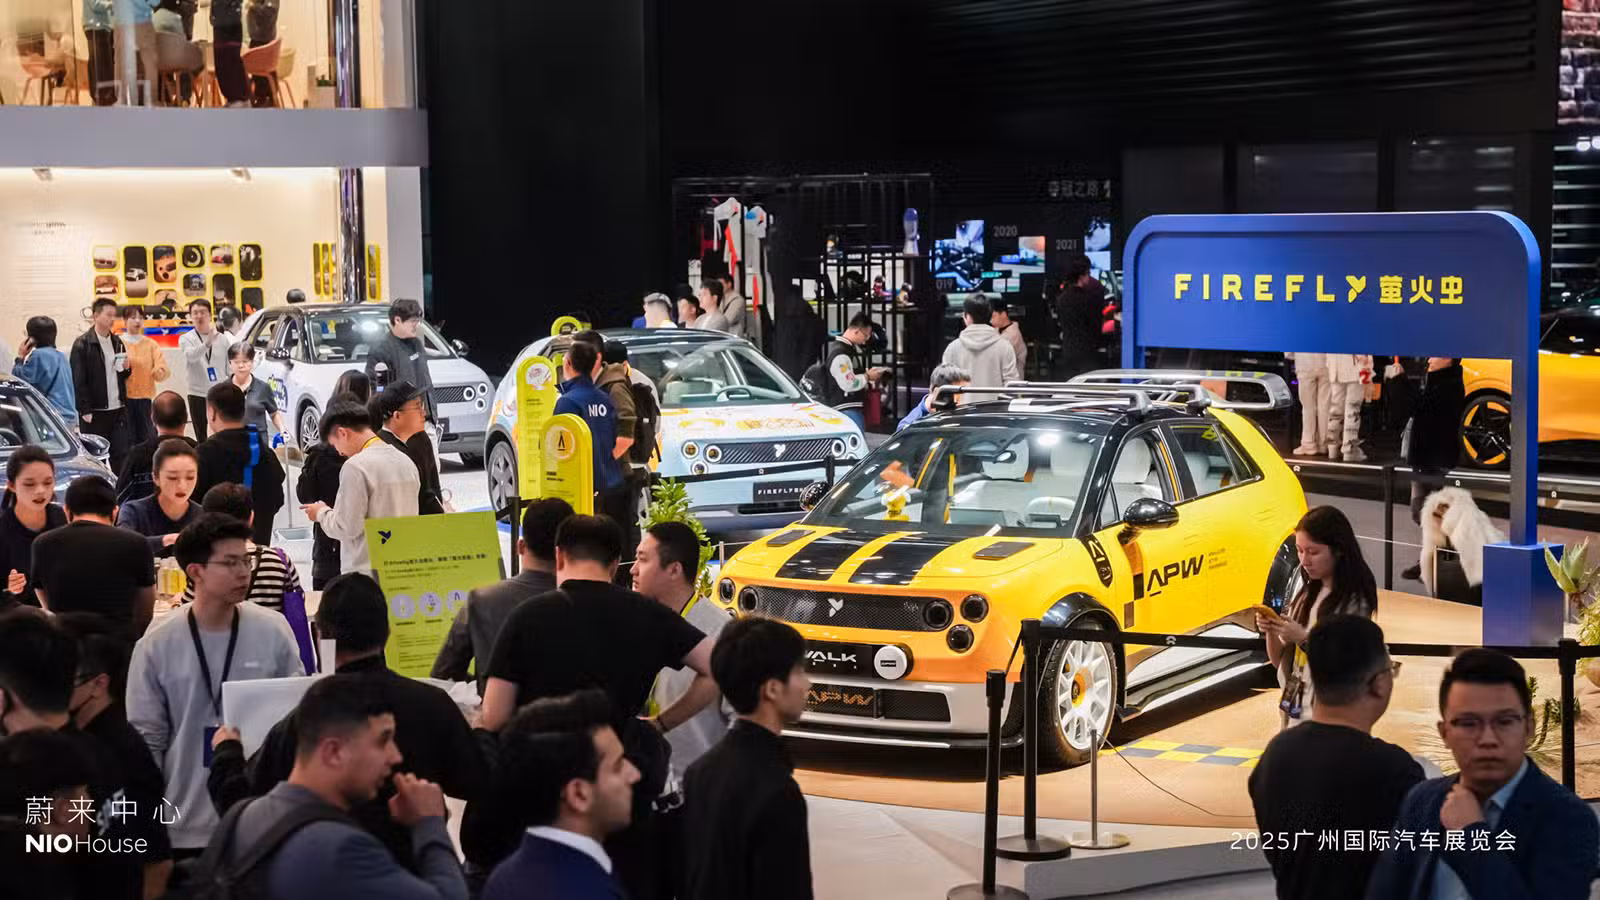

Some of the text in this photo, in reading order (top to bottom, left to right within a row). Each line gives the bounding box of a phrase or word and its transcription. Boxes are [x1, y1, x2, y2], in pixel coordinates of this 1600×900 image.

[993, 225, 1018, 237] 2020
[1055, 239, 1077, 250] 2021
[935, 278, 953, 290] 019
[1174, 273, 1463, 305] FIREFLY 萤火虫
[588, 403, 607, 417] NIO
[1146, 554, 1204, 597] APW
